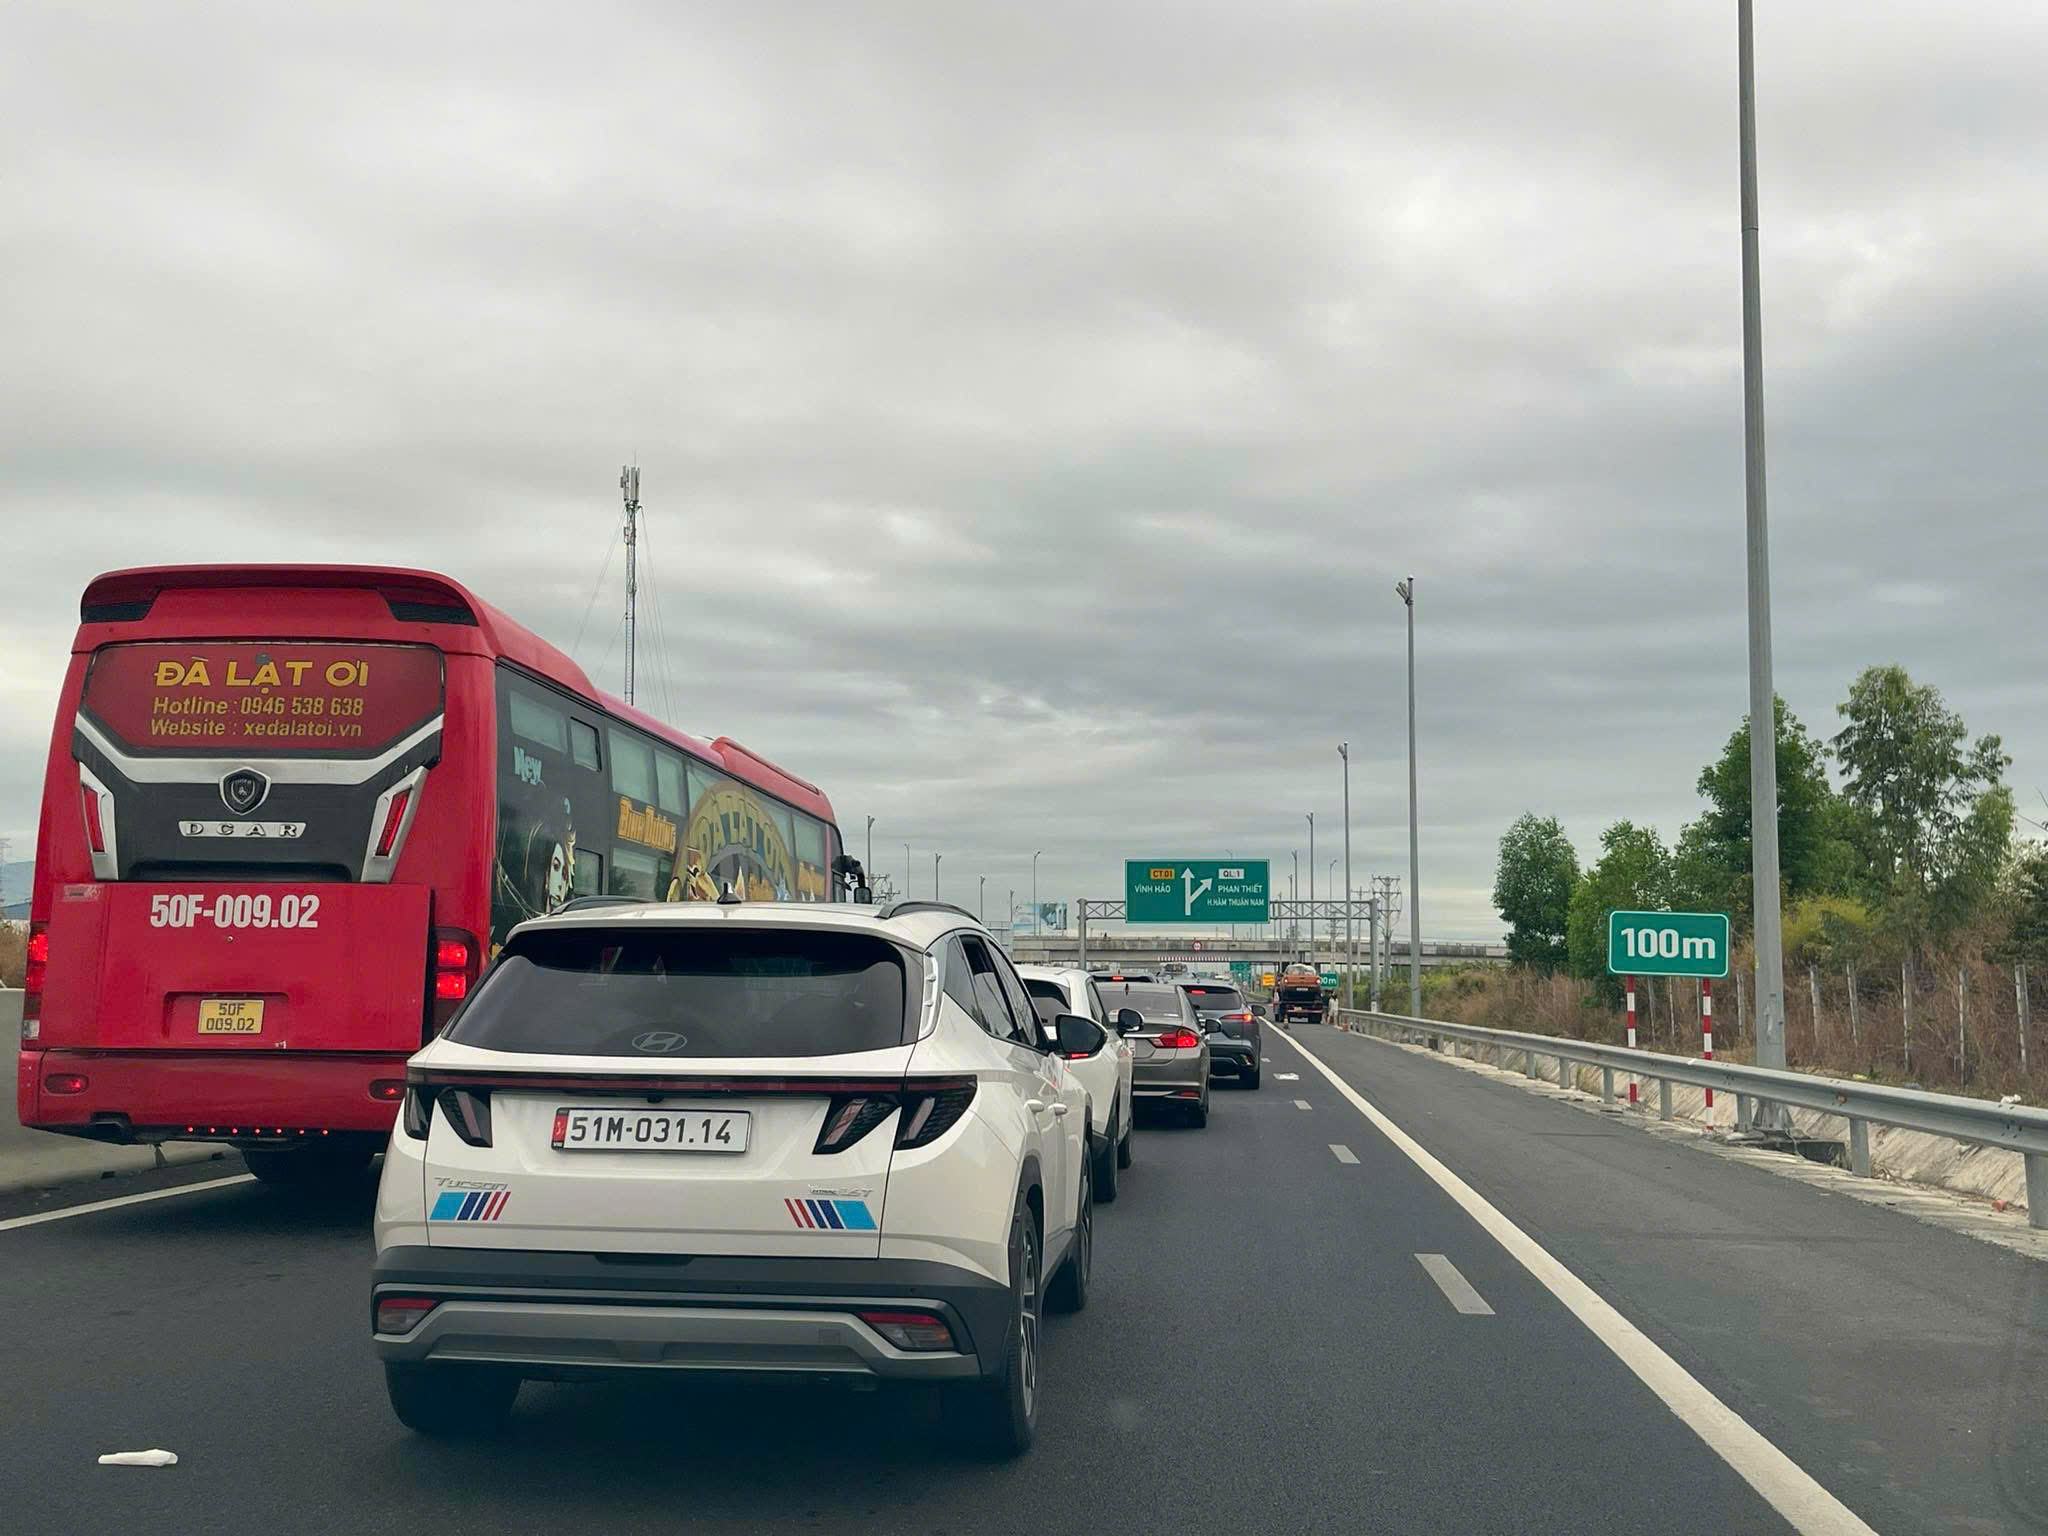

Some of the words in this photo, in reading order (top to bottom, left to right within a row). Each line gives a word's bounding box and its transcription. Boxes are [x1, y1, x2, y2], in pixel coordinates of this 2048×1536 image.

[154, 656, 211, 687] ĐÀ
[226, 660, 313, 695] LẠT
[240, 696, 286, 715] 0946
[291, 696, 324, 715] 538
[330, 697, 364, 716] 638
[243, 719, 362, 737] xedalatoi.vn
[1218, 885, 1240, 893] PHAN
[150, 894, 320, 928] 50F-009.02
[218, 1002, 245, 1016] 50F
[205, 1017, 255, 1032] 009.02
[570, 1116, 731, 1144] 51M-031.14
